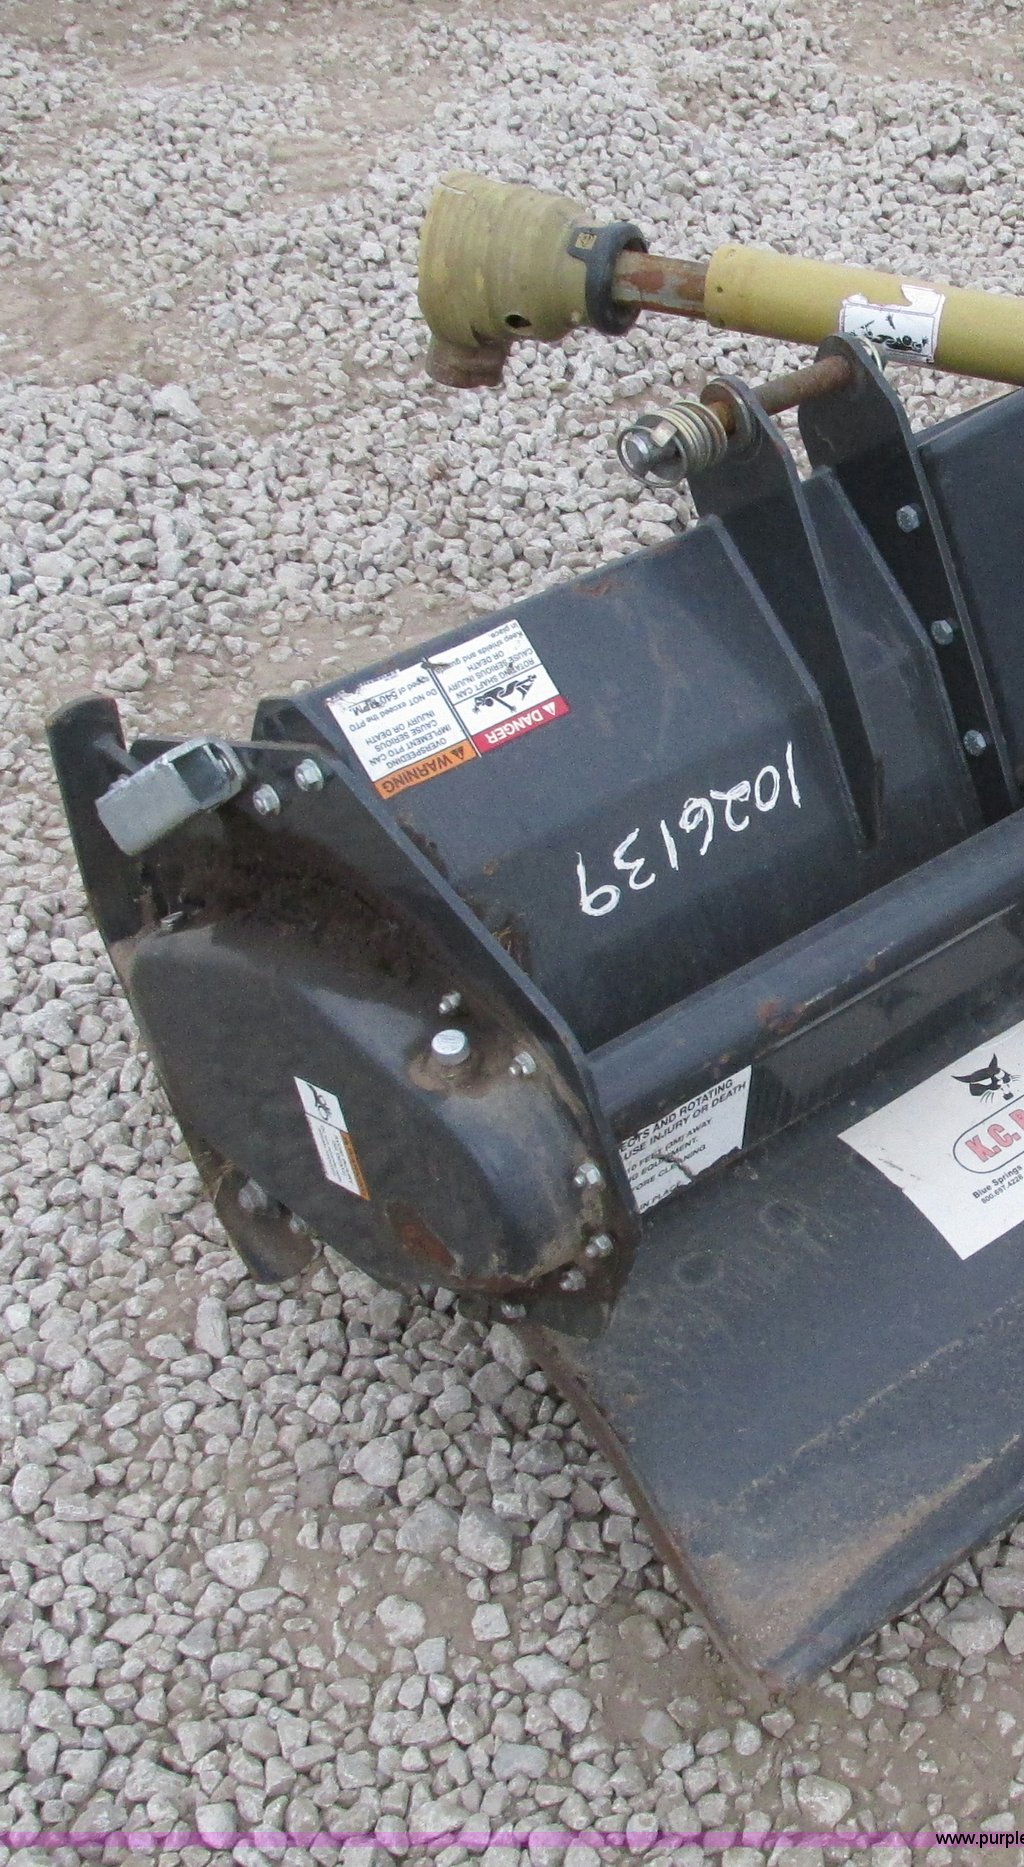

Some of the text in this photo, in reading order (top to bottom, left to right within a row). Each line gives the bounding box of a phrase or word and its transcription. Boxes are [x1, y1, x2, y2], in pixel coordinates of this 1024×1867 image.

[477, 640, 503, 654] shields
[504, 631, 523, 641] Keep
[447, 648, 534, 692] CAUSE SERIOUS INJURY
[462, 651, 477, 662] and
[467, 650, 504, 671] OR DEATH
[398, 687, 407, 695] of
[456, 687, 473, 698] CAN
[477, 674, 500, 689] SHAFT
[349, 688, 438, 732] Do NOT exceed the PTO
[380, 691, 398, 706] 540
[365, 710, 435, 745] INJURY OR DEATH
[374, 719, 438, 752] CAUSE SERIOUS
[484, 712, 544, 745] DANGER
[369, 724, 452, 766] IMPLEMENT PTO CAN
[386, 737, 447, 769] OVERSPEEDING
[382, 755, 451, 793] WARNING
[575, 740, 801, 917] 1026139
[650, 1116, 690, 1145] INJURY
[692, 1105, 709, 1118] OR
[711, 1081, 747, 1108] DEATH
[653, 1113, 677, 1131] AND
[679, 1079, 733, 1116] ROTATING
[686, 1118, 713, 1137] AWAY
[964, 1123, 1021, 1162] K.C.
[972, 1164, 1023, 1199] Blue Springs
